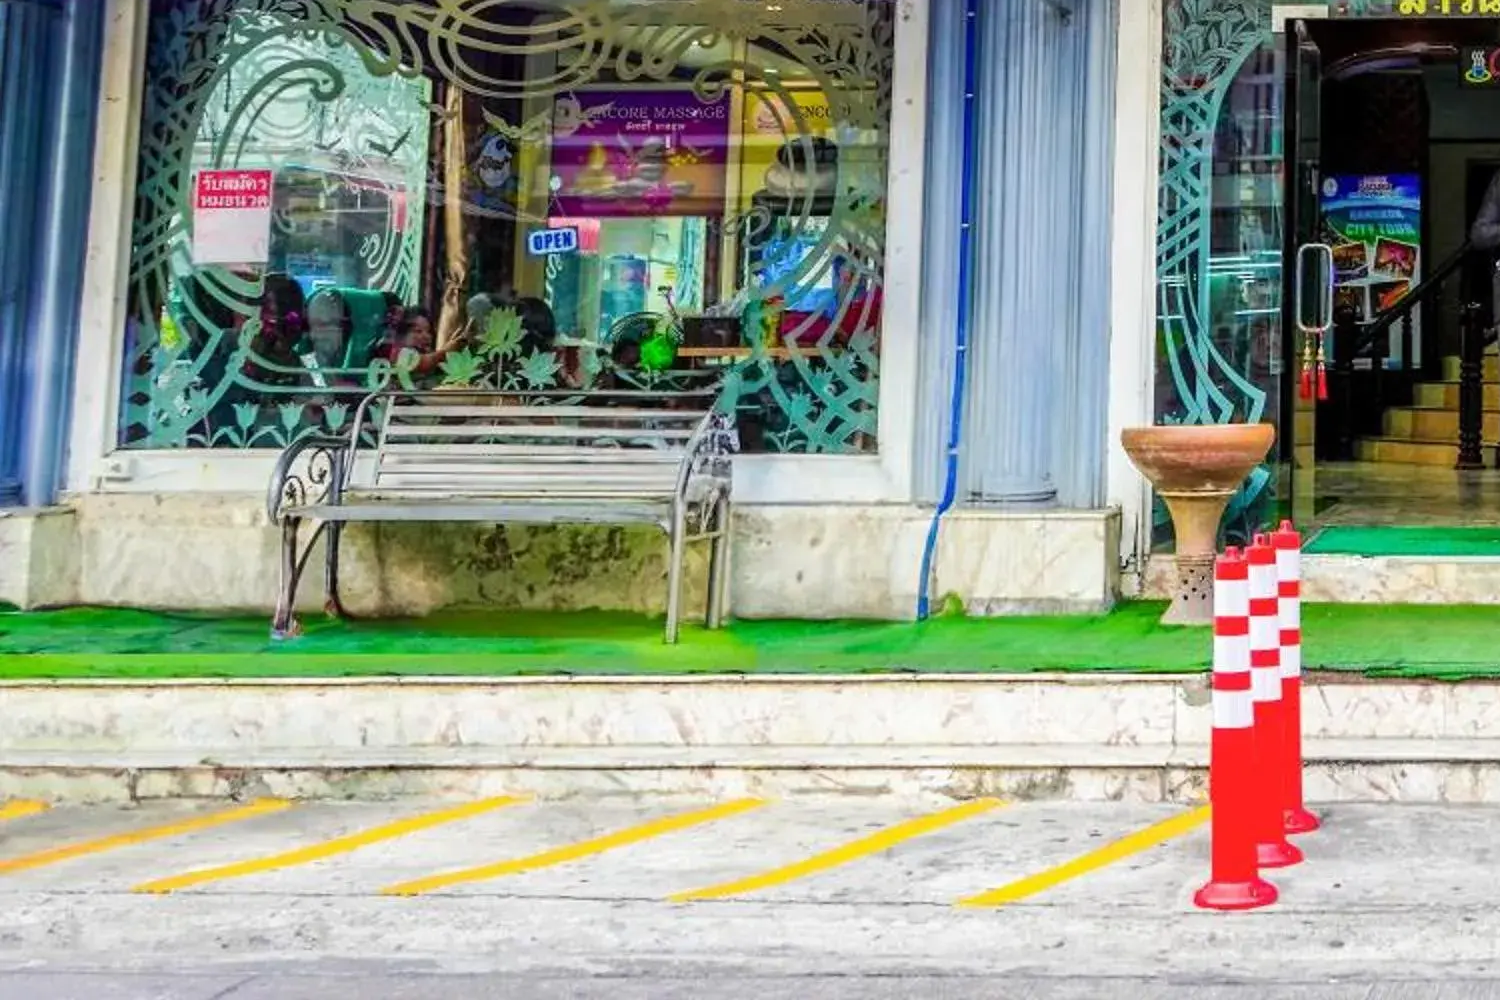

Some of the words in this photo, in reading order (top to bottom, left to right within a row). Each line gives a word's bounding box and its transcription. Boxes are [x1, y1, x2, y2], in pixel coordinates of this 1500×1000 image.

[653, 104, 725, 120] MASSAGE
[202, 174, 268, 191] รับสมัคร
[533, 231, 573, 251] OPEN
